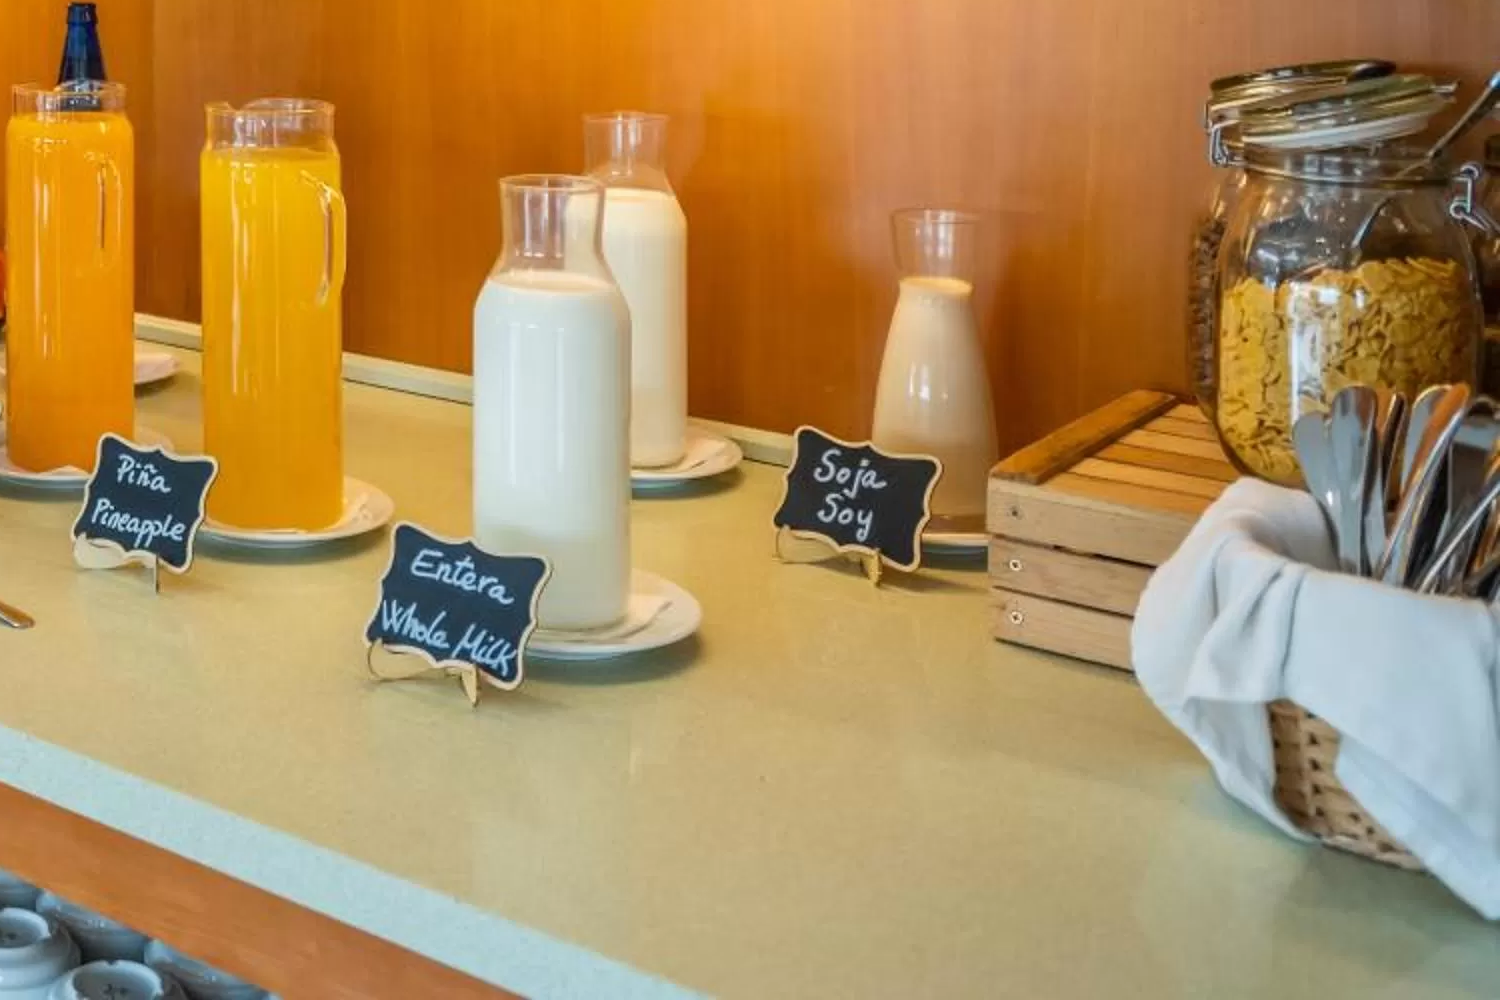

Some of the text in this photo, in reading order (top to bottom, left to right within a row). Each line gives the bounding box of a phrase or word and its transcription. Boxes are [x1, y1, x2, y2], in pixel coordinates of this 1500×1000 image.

[116, 453, 171, 493] Piña
[813, 449, 887, 499] Soja
[91, 498, 186, 548] Pineapple
[816, 493, 873, 542] Soy
[411, 549, 514, 605] Entera
[382, 600, 516, 677] Whole Milk
